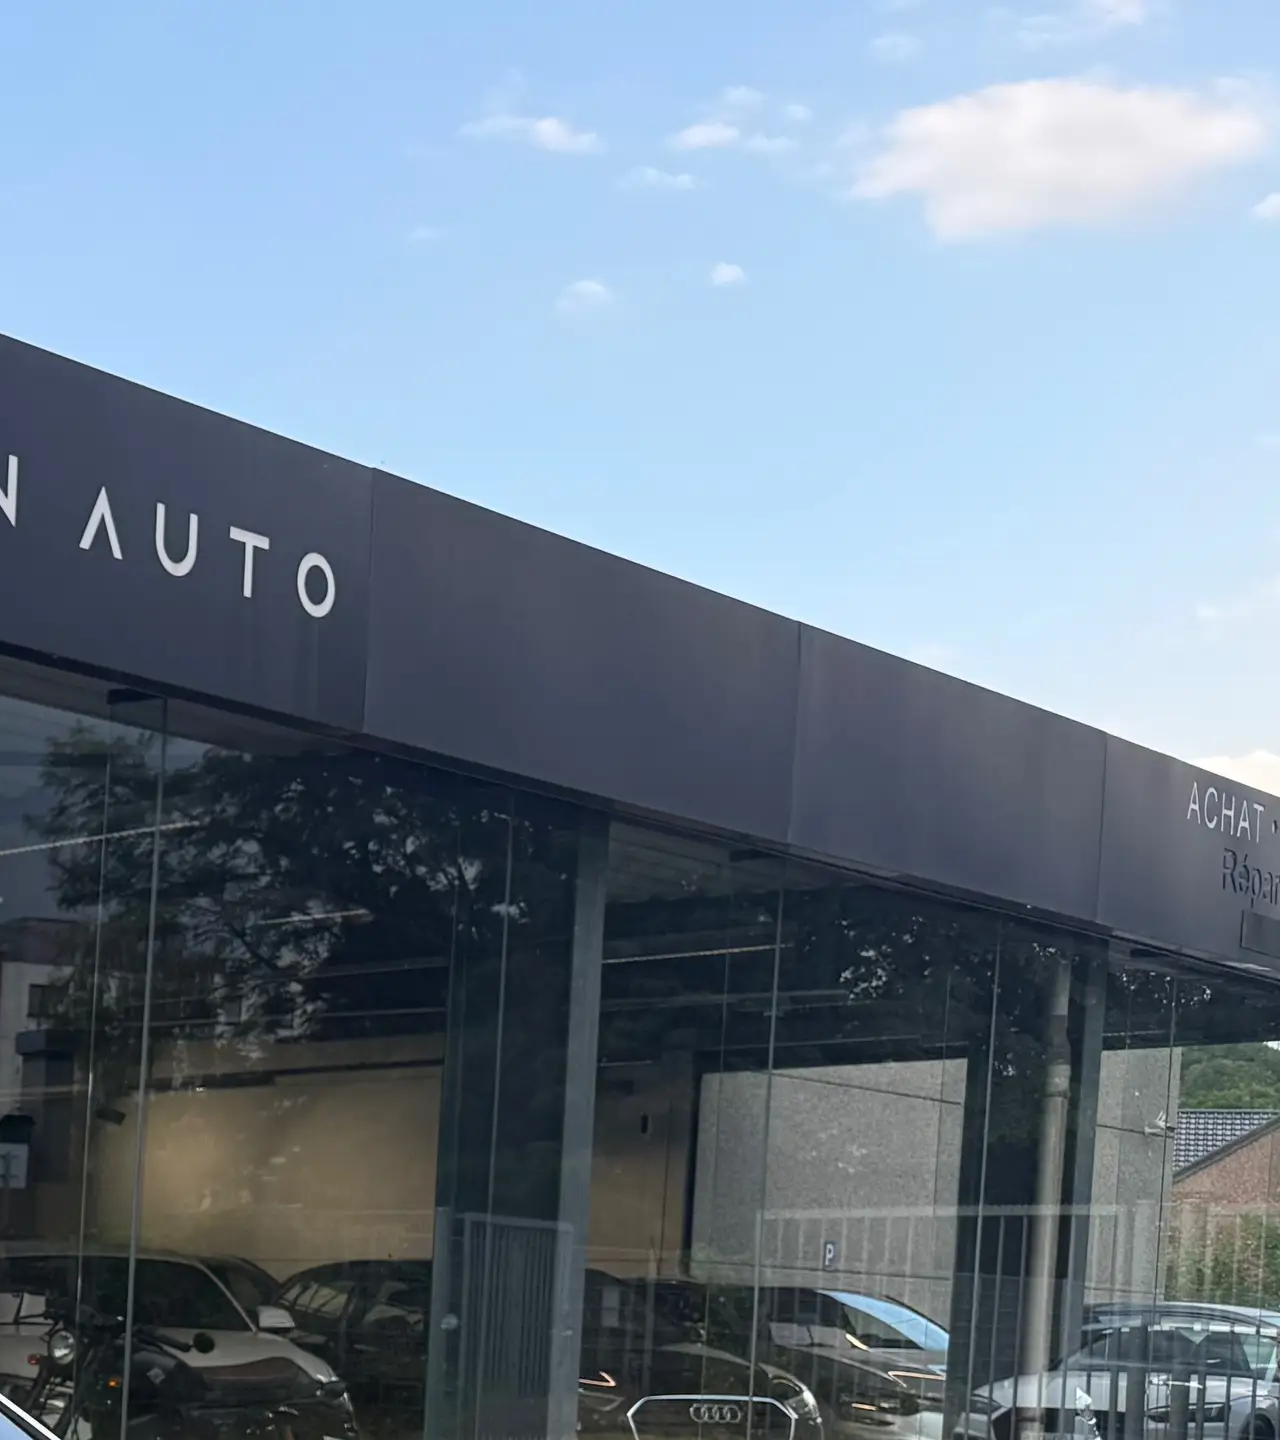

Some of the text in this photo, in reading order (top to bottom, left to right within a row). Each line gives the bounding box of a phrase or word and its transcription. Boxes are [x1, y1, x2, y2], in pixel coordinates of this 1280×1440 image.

[79, 486, 336, 618] AUTO
[1186, 781, 1265, 844] ACHAT
[825, 1243, 835, 1266] P
